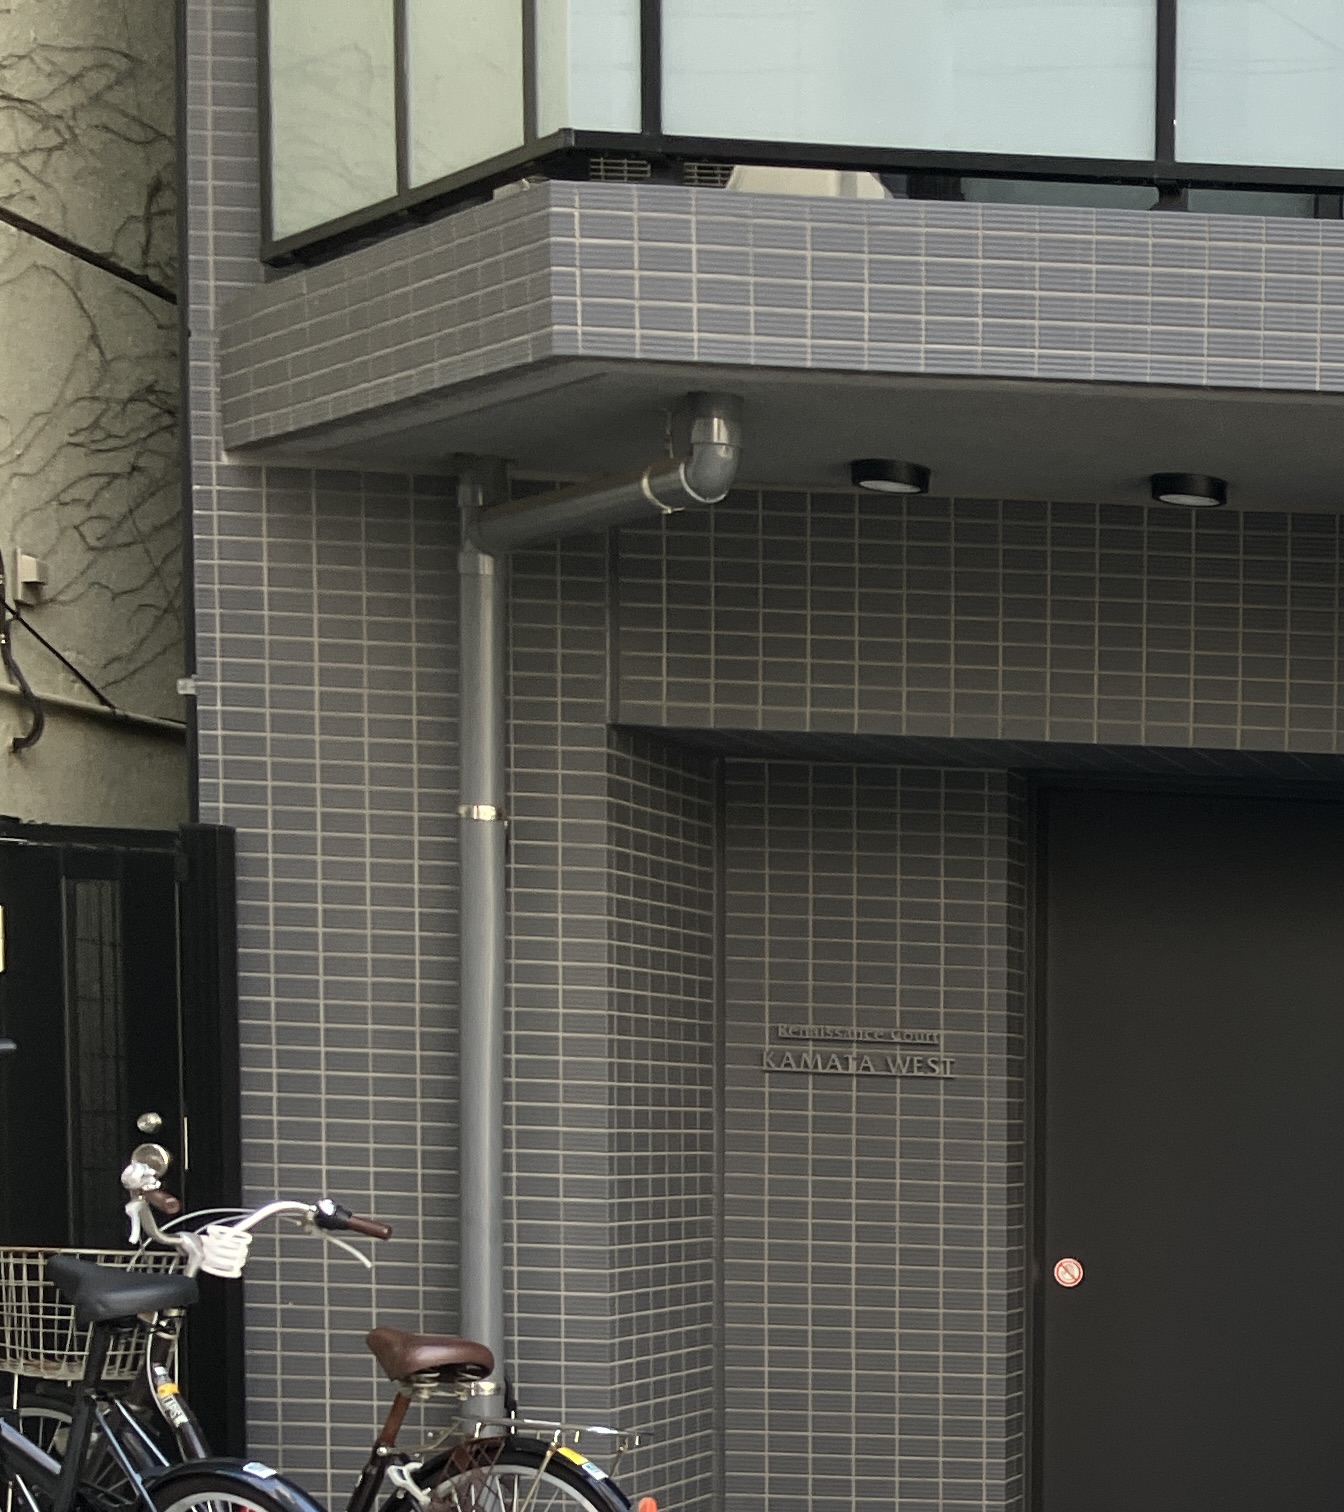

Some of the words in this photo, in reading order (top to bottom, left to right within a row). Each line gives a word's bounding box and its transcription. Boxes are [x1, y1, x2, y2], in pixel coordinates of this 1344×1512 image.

[778, 1024, 884, 1041] Renaissance
[891, 1029, 939, 1043] Court
[762, 1051, 875, 1073] KAMATA
[887, 1056, 956, 1077] WEST
